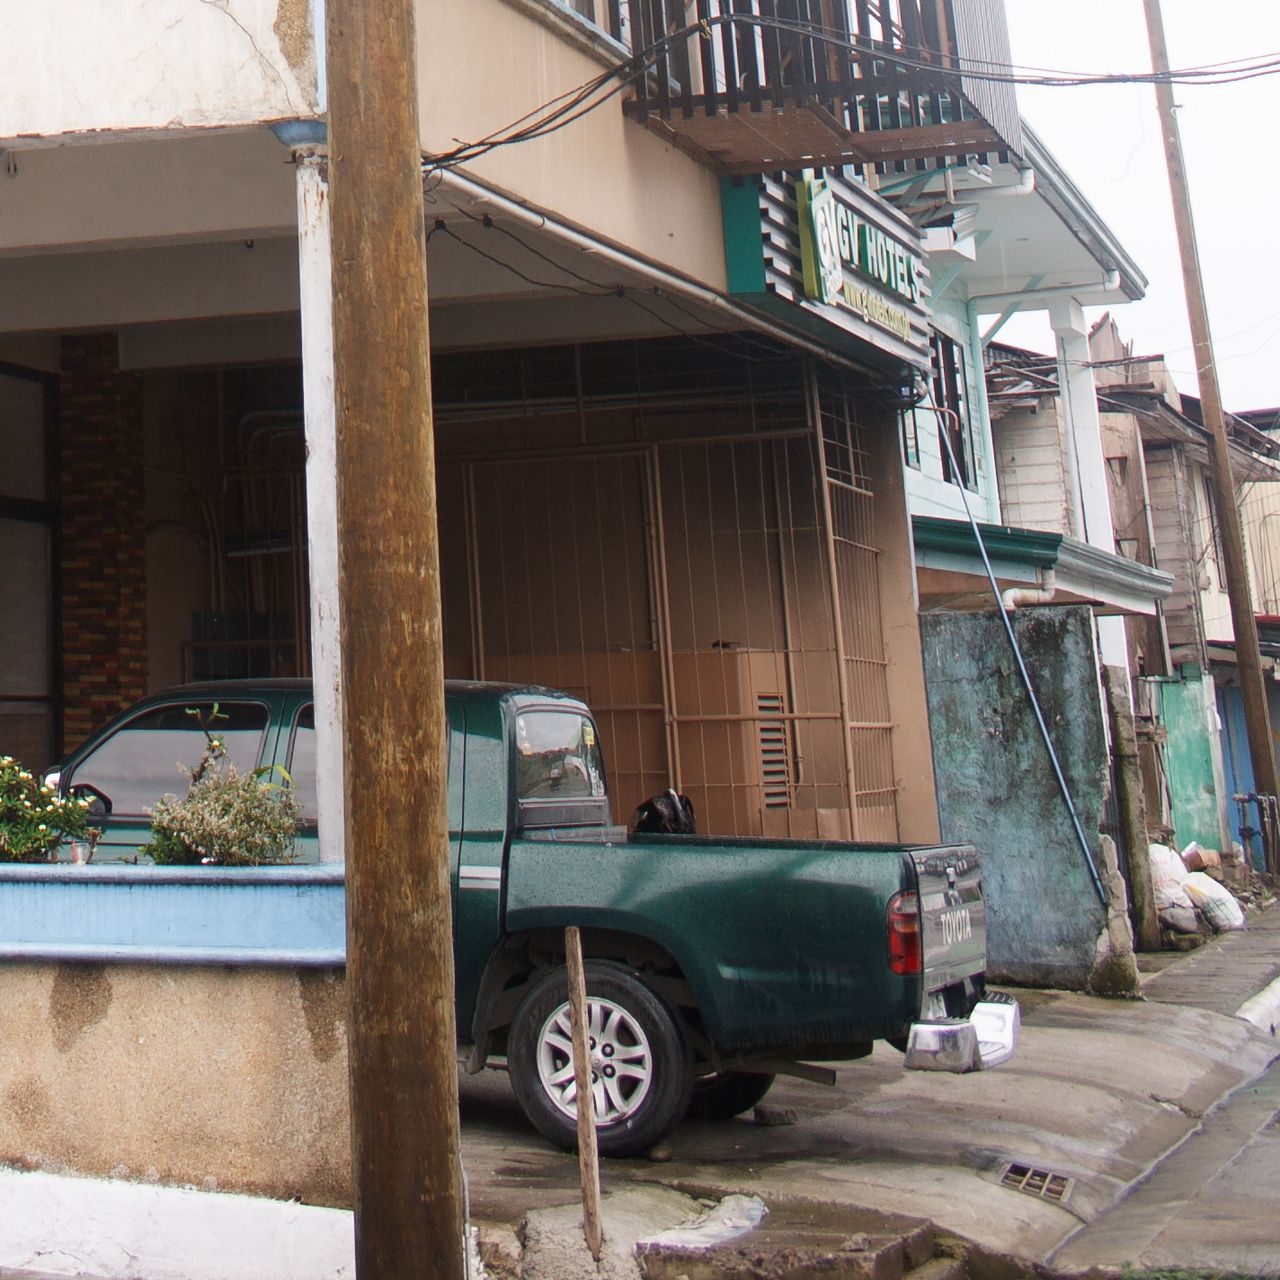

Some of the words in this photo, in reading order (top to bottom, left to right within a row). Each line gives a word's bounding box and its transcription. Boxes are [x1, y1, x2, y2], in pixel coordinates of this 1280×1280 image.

[836, 202, 860, 265] GV
[864, 222, 921, 305] HOTELS
[940, 908, 972, 945] TOYOTA
